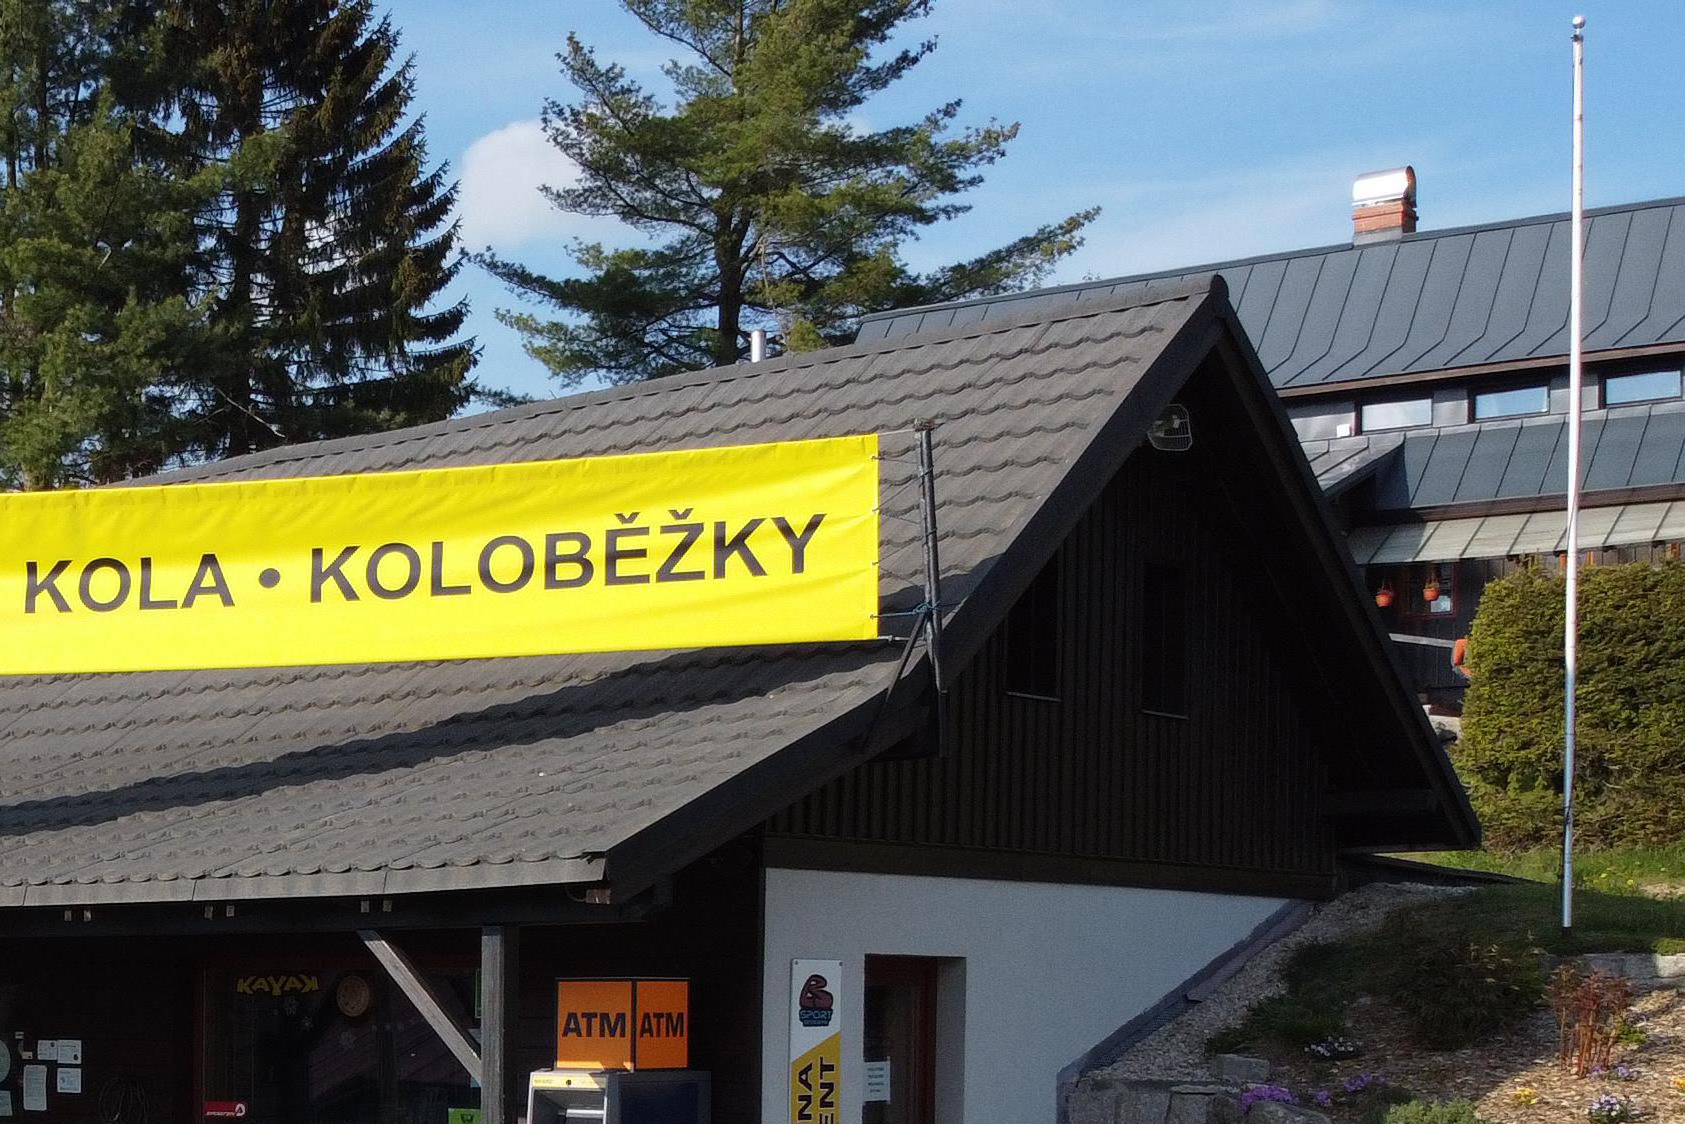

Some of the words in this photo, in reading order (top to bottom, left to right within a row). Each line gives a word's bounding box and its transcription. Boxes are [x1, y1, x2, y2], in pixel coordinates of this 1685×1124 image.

[25, 553, 235, 613] KOLA
[311, 508, 826, 602] KOLOBĚŽKY
[562, 1012, 626, 1038] ATM
[639, 1012, 684, 1038] ATM
